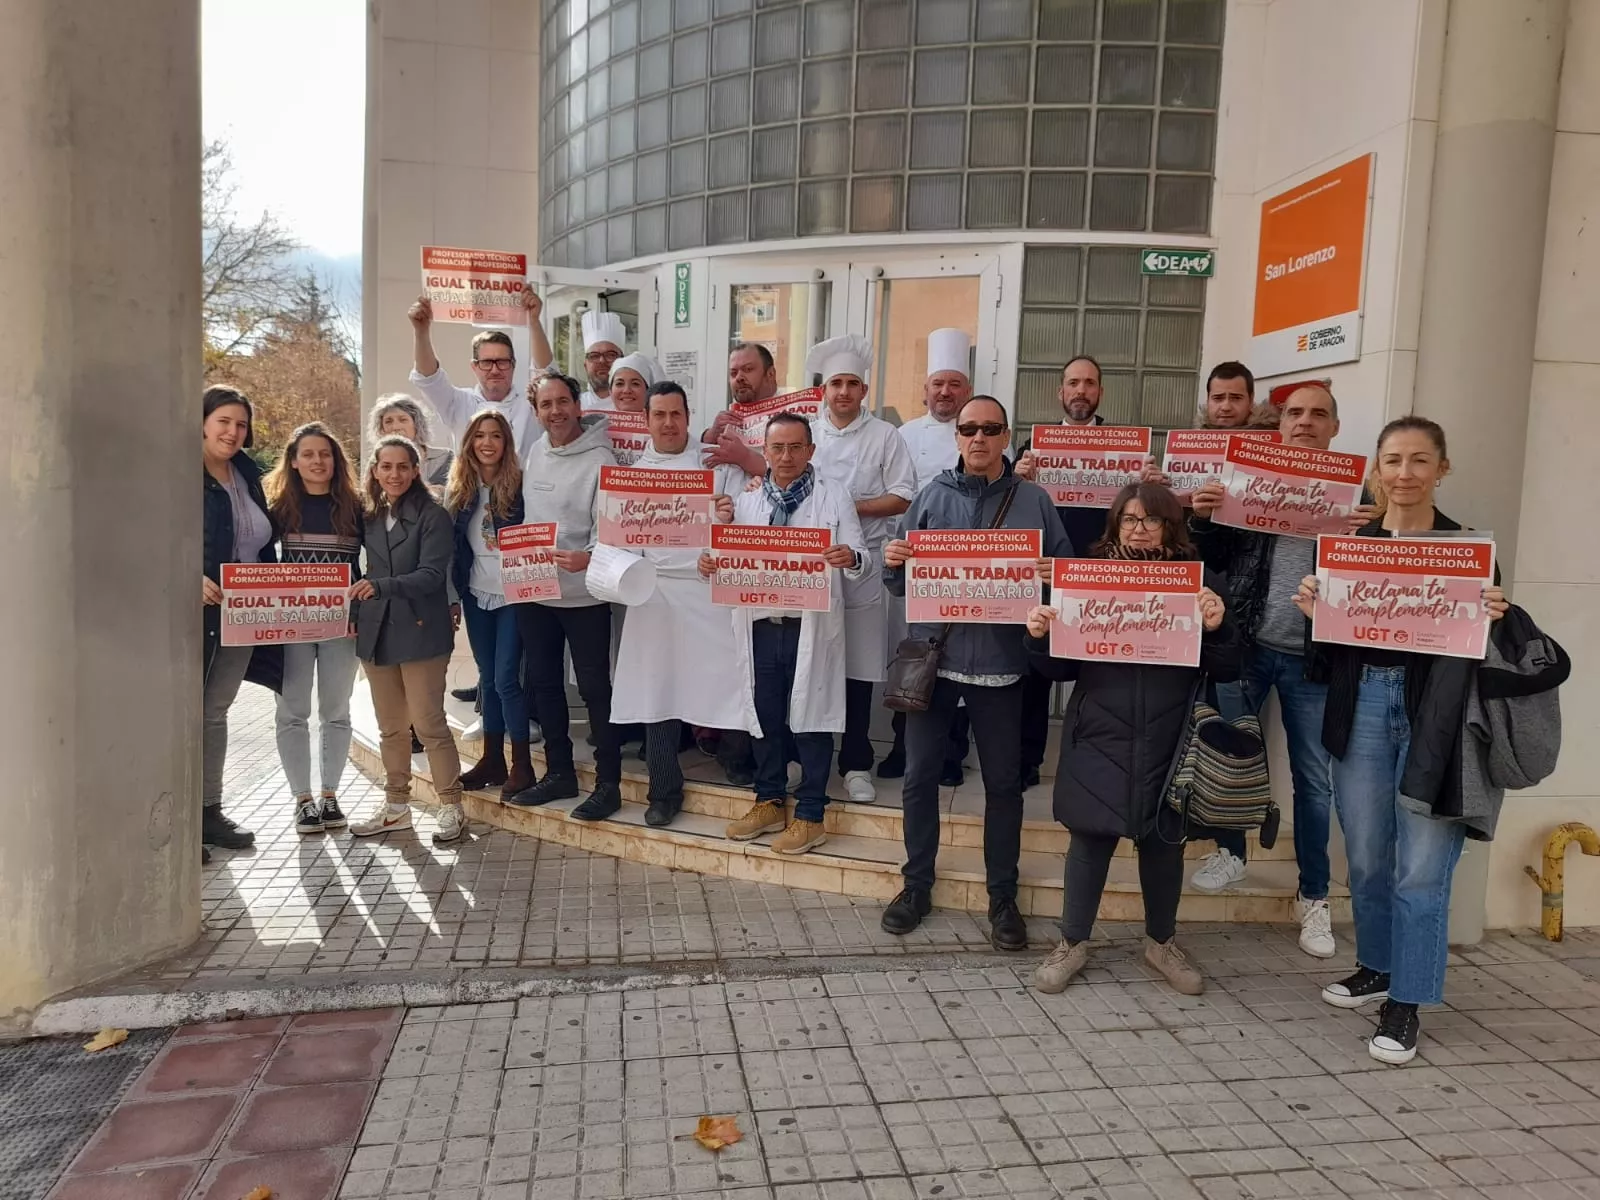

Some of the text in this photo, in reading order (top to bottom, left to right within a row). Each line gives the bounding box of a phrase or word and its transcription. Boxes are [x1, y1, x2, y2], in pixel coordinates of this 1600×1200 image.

[432, 250, 517, 262] PROFESORADO TÉCNICO
[428, 257, 522, 270] FORMACIÓN PROFESIONAL
[1158, 256, 1190, 270] DEA
[1265, 245, 1336, 281] San Lorenzo
[426, 276, 522, 294] IGUAL TRABAJO
[449, 308, 472, 319] UGT
[1310, 325, 1342, 340] GOBIERNO
[1309, 341, 1317, 350] DE
[1044, 428, 1138, 438] PROFESORADO TÉCNICO
[1040, 436, 1088, 444] FORMACIÓN
[1241, 442, 1309, 460] PROFESORADO
[1312, 452, 1352, 466] TÉCNICO
[1036, 456, 1142, 473] IGUAL TRABAJO
[1168, 462, 1208, 474] IGUAL
[1234, 450, 1357, 477] FORMACIÓN PROFESIONAL
[610, 470, 704, 480] PROFESORADO TÉCNICO
[606, 478, 708, 489] FORMACIÓN PROFESIONAL
[1245, 476, 1327, 498] ¡Reclama tu
[1058, 492, 1083, 502] UGT
[620, 496, 688, 516] ¡Reclama tu
[1242, 494, 1332, 516] complemento!
[620, 510, 695, 532] complemento!
[1246, 514, 1276, 529] UGT
[626, 534, 652, 544] UGT
[724, 528, 820, 539] PROFESORADO TÉCNICO
[920, 532, 1028, 542] PROFESORADO TÉCNICO
[718, 536, 824, 548] FORMACIÓN PROFESIONAL
[914, 542, 1034, 552] FORMACIÓN PROFESIONAL
[1334, 541, 1474, 557] PROFESORADO TÉCNICO
[502, 556, 521, 568] IGUAL
[716, 557, 825, 574] IGUAL TRABAJO
[1327, 552, 1482, 569] FORMACIÓN PROFESIONAL
[236, 566, 338, 575] PROFESORADO TÉCNICO
[912, 566, 1034, 582] IGUAL TRABAJO
[1068, 563, 1187, 574] PROFESORADO TÉCNICO
[230, 575, 343, 584] FORMACIÓN PROFESIONAL
[716, 573, 826, 590] IGUAL SALARIO
[1062, 573, 1194, 586] FORMACIÓN PROFESIONAL
[518, 587, 532, 598] UGT
[912, 584, 1035, 599] IGUAL SALARIO
[1347, 578, 1448, 601] ¡Reclama tu
[228, 595, 344, 608] IGUAL TRABAJO
[740, 592, 766, 604] UGT
[940, 606, 968, 616] UGT
[1078, 595, 1166, 619] ¡Reclama tu
[1347, 597, 1458, 624] complemento!
[228, 610, 344, 626] IGUAL SALARIO
[1079, 614, 1175, 640] complemento!
[254, 630, 282, 640] UGT
[1354, 626, 1390, 642] UGT
[1086, 642, 1118, 656] UGT
